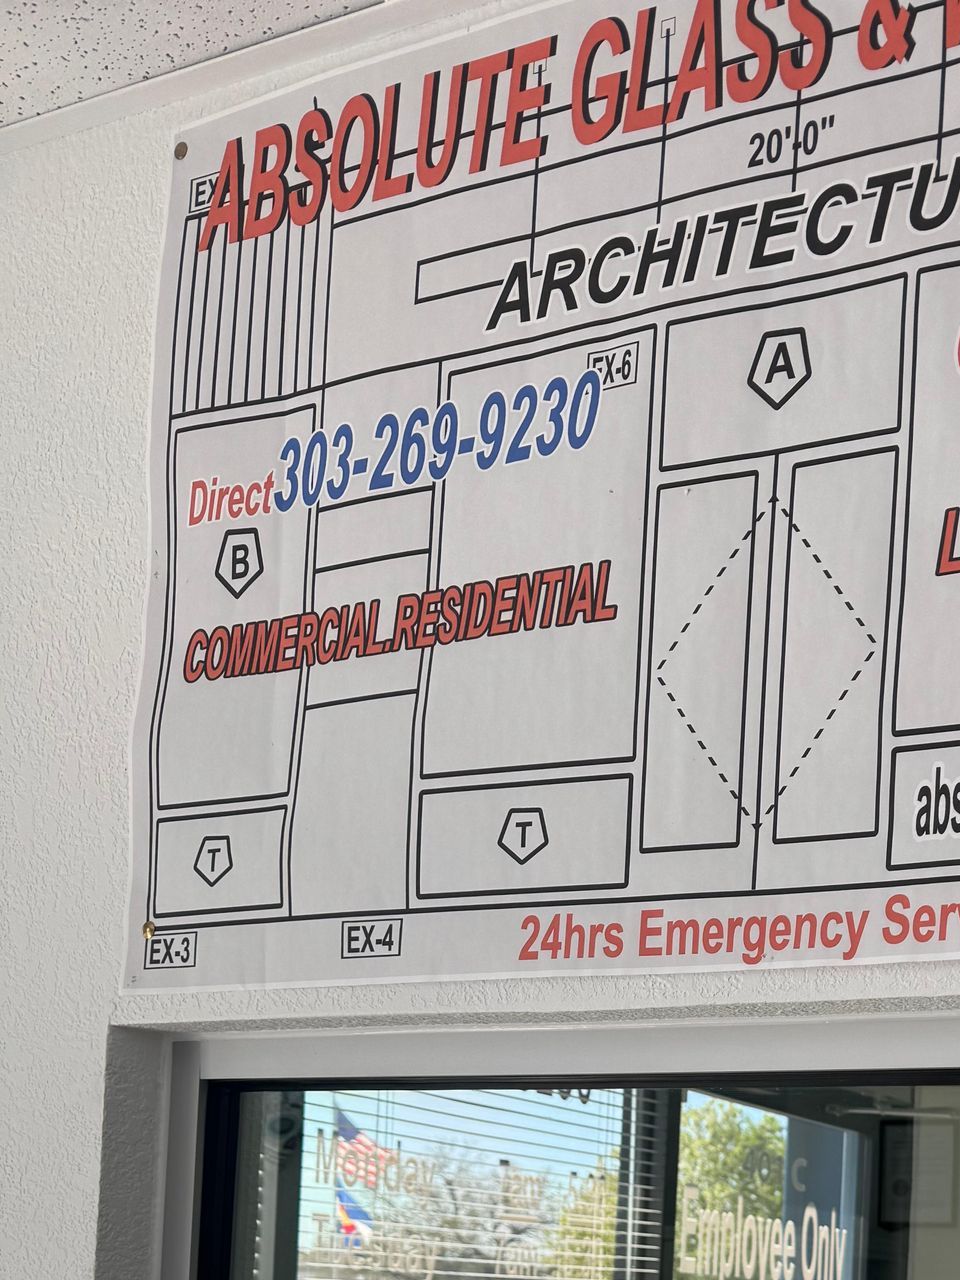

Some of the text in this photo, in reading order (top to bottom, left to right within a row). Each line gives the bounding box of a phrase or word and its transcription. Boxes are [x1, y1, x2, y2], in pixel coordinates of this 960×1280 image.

[198, 0, 915, 252] ABSOLUTE GLASS &
[764, 341, 796, 385] A
[187, 369, 602, 527] Direct 303-269-9230
[230, 543, 250, 581] B
[182, 559, 617, 683] COMMERCIAL.RESIDENTIAL
[515, 821, 533, 848] T
[207, 847, 222, 872] T
[149, 939, 191, 965] EX-3
[346, 923, 395, 954] EX-4
[518, 913, 624, 961] 24hrs
[638, 908, 870, 966] Emergency
[315, 1128, 436, 1210] Monday
